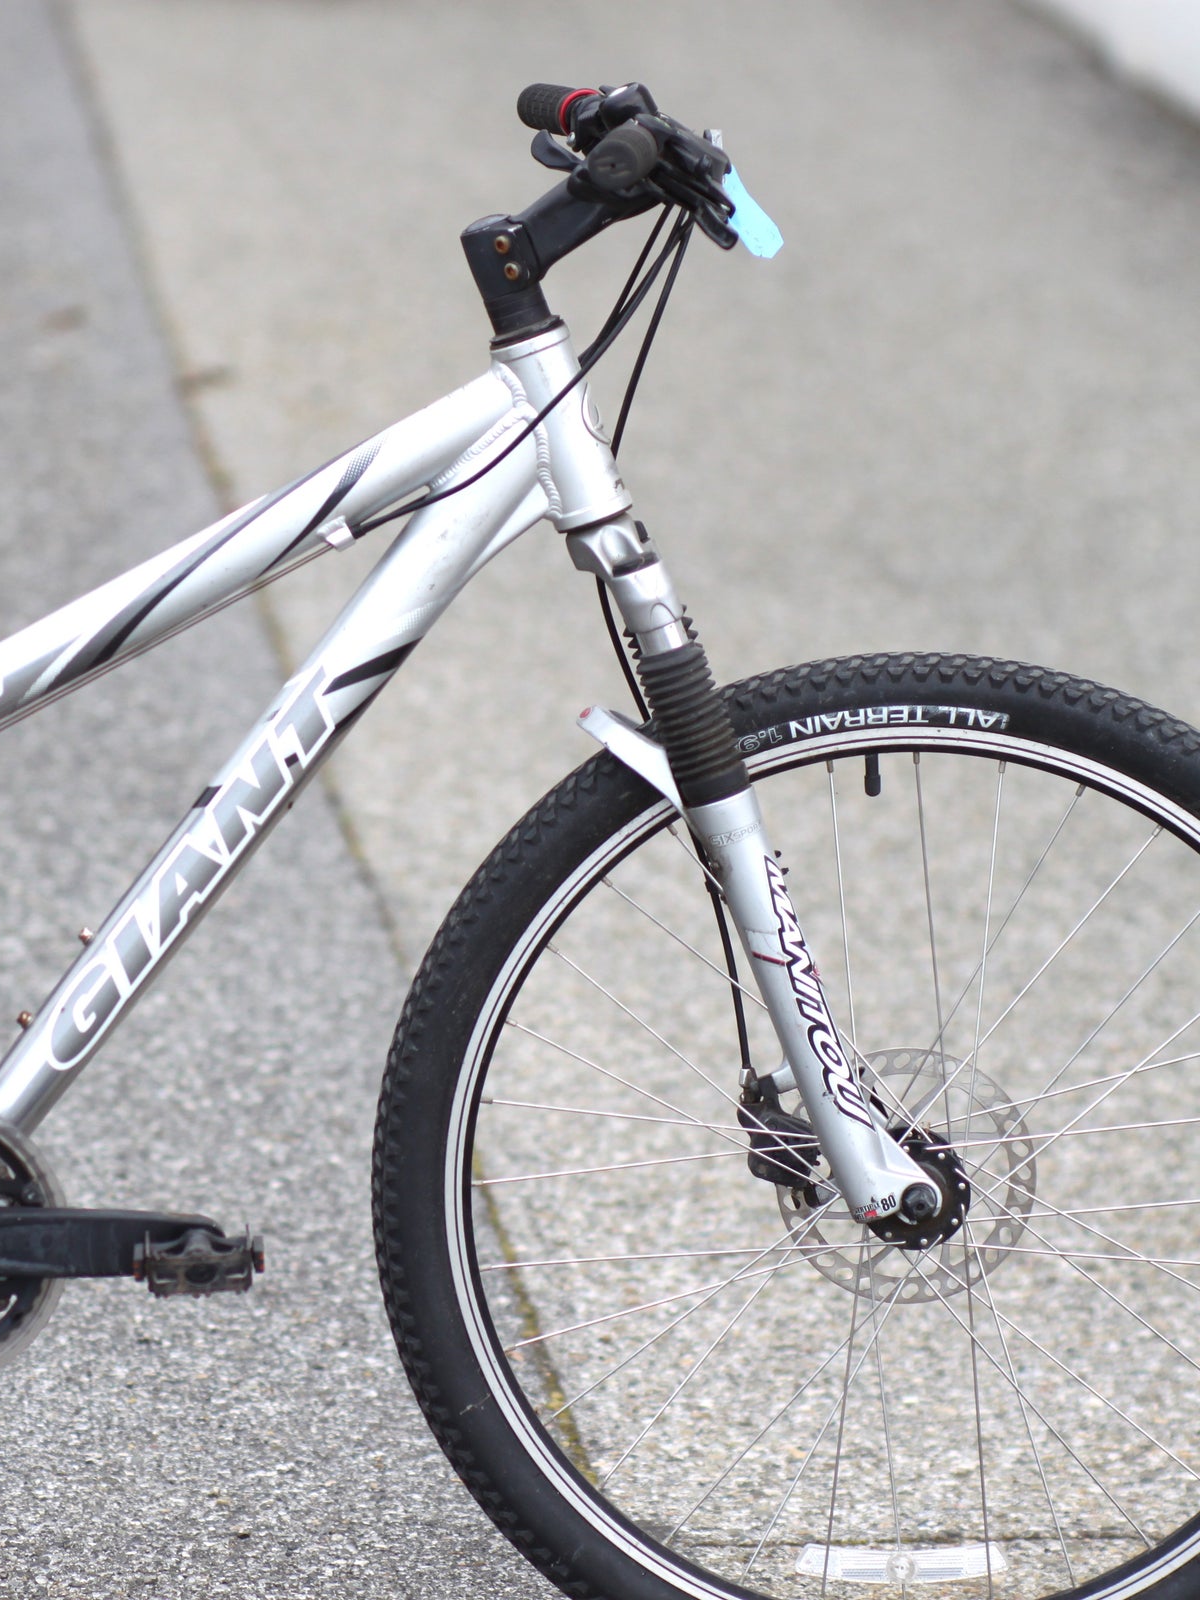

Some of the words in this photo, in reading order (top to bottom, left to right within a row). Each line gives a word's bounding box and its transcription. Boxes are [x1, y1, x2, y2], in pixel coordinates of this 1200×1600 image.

[789, 705, 930, 739] TERRAIN
[735, 727, 783, 752] 1.9
[47, 663, 336, 1070] GIANT
[764, 855, 877, 1132] MANITOU
[881, 1194, 897, 1211] 80
